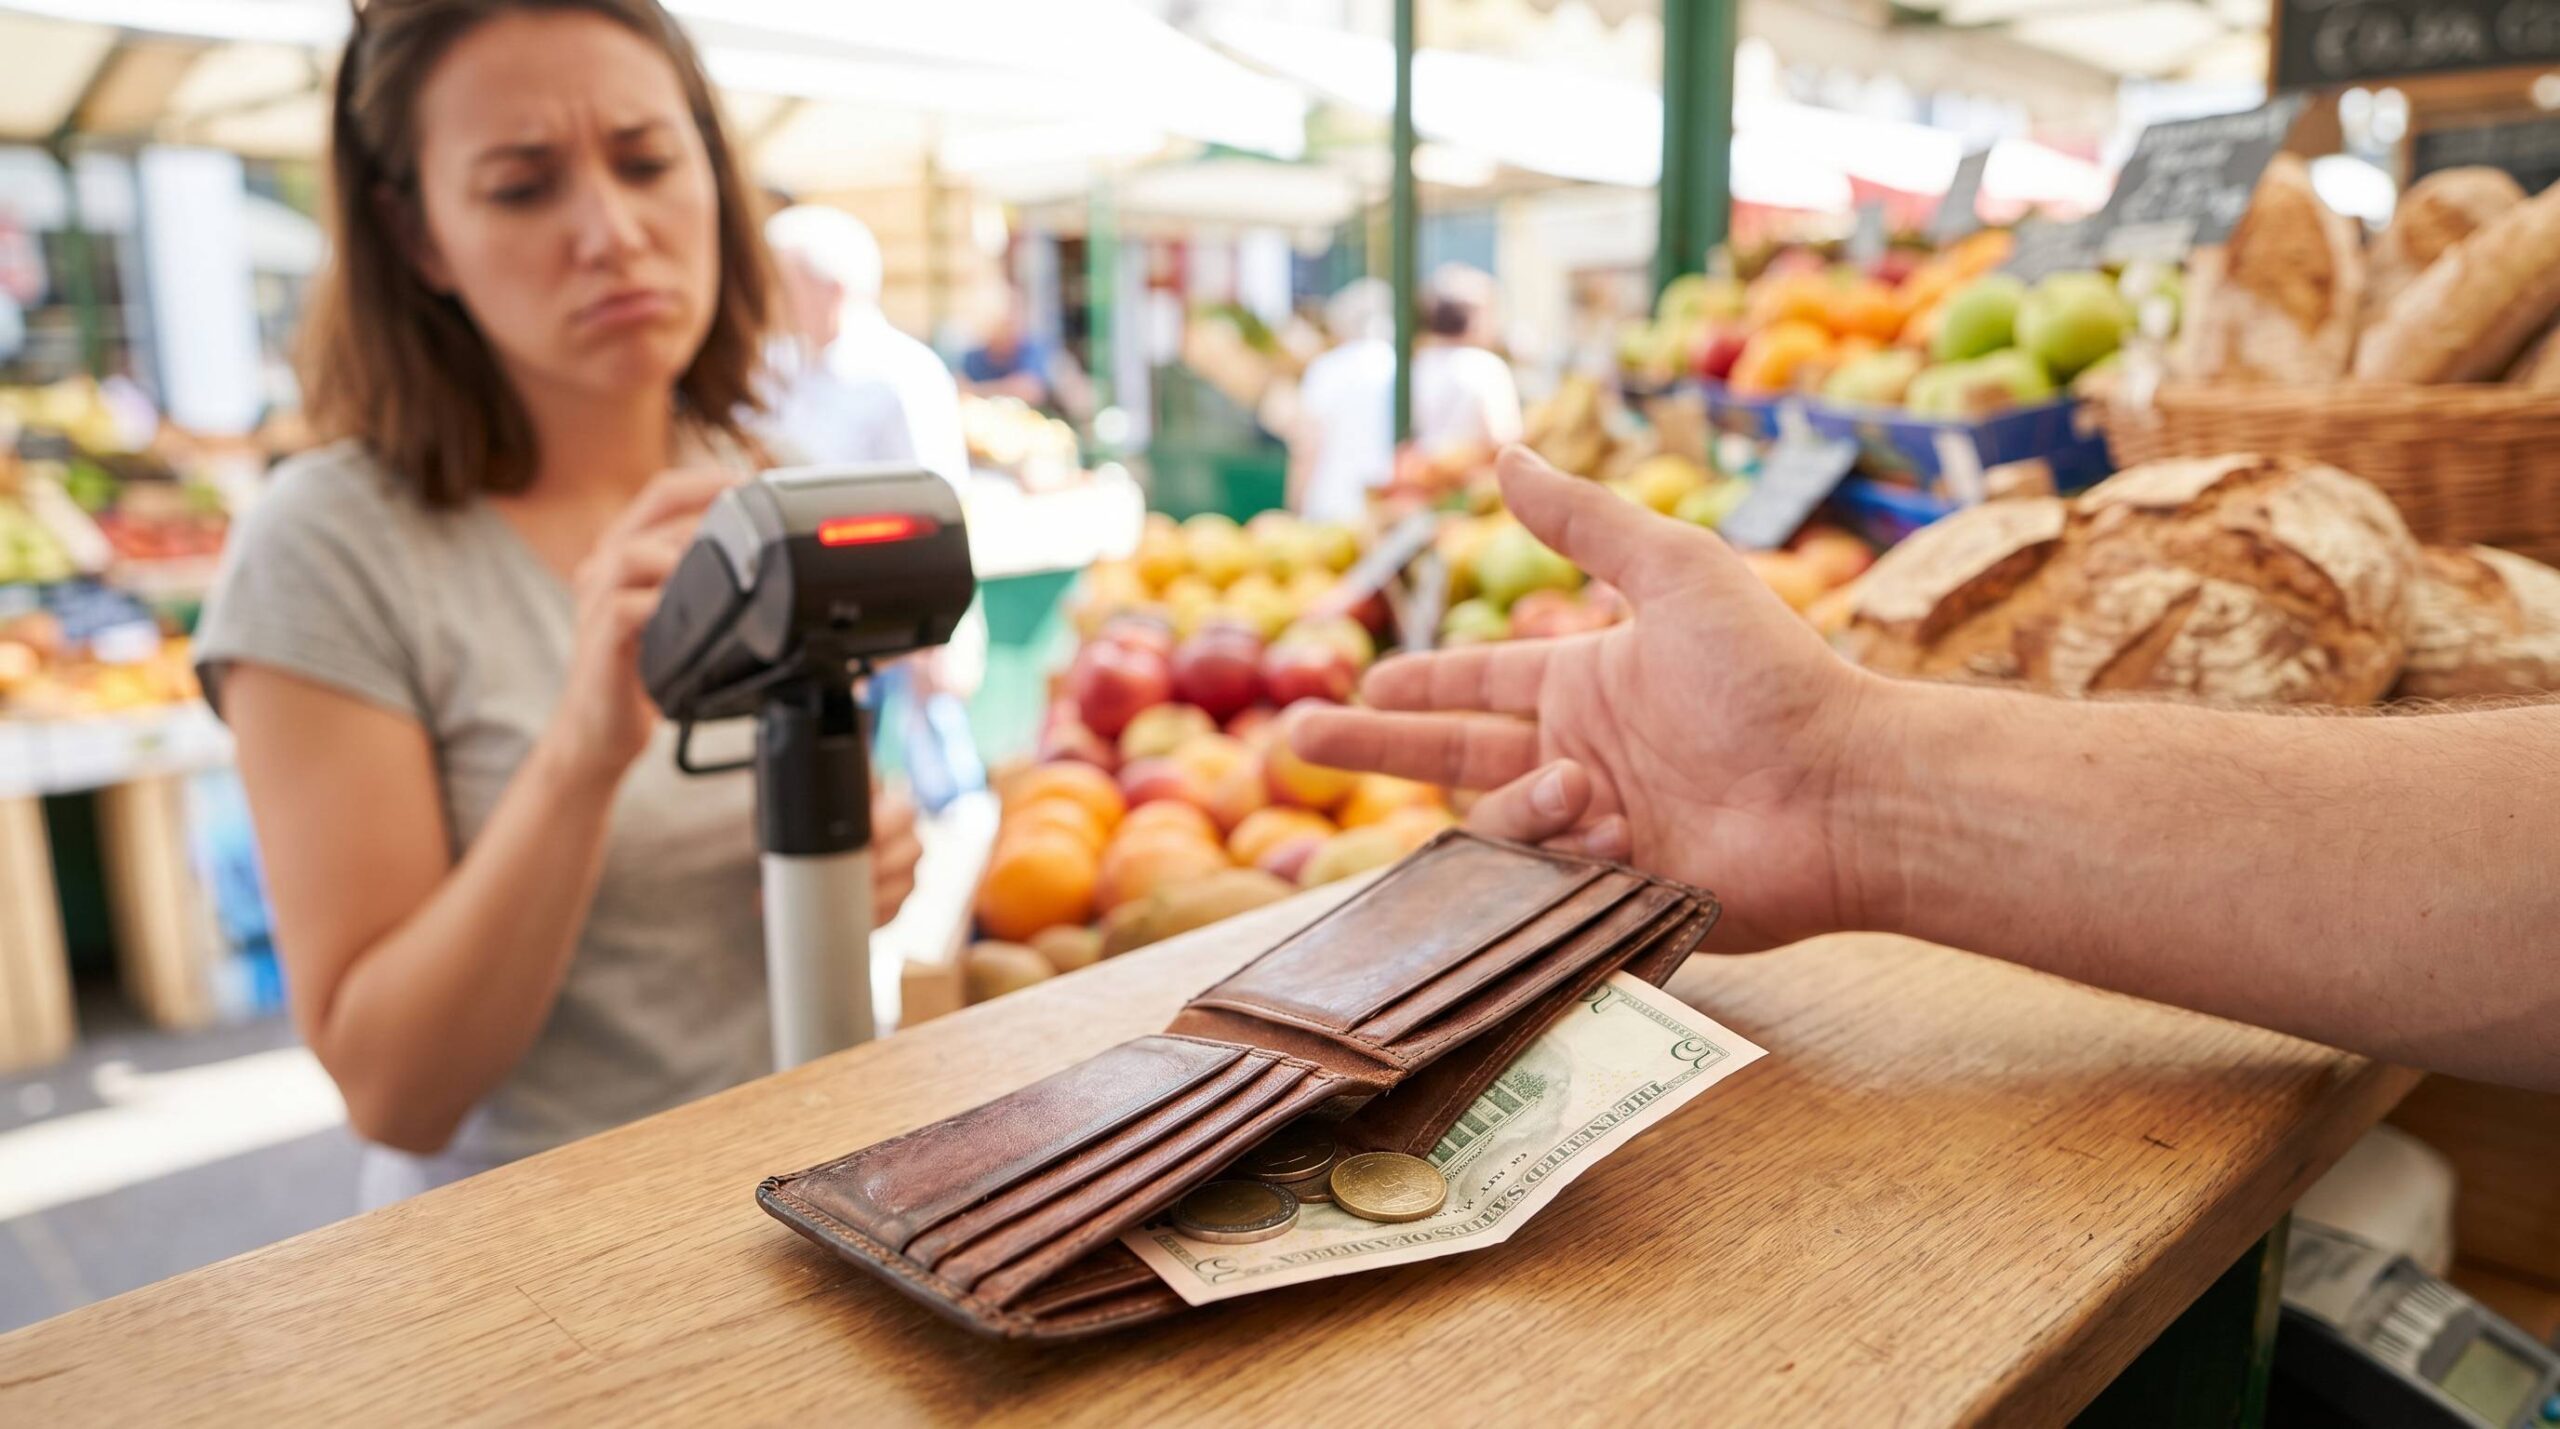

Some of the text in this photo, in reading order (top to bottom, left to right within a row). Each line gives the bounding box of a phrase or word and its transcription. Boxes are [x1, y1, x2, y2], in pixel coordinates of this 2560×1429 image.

[1671, 1037, 1719, 1069] 5
[1618, 1083, 1667, 1117] THE
[1194, 1256, 1240, 1285] 5
